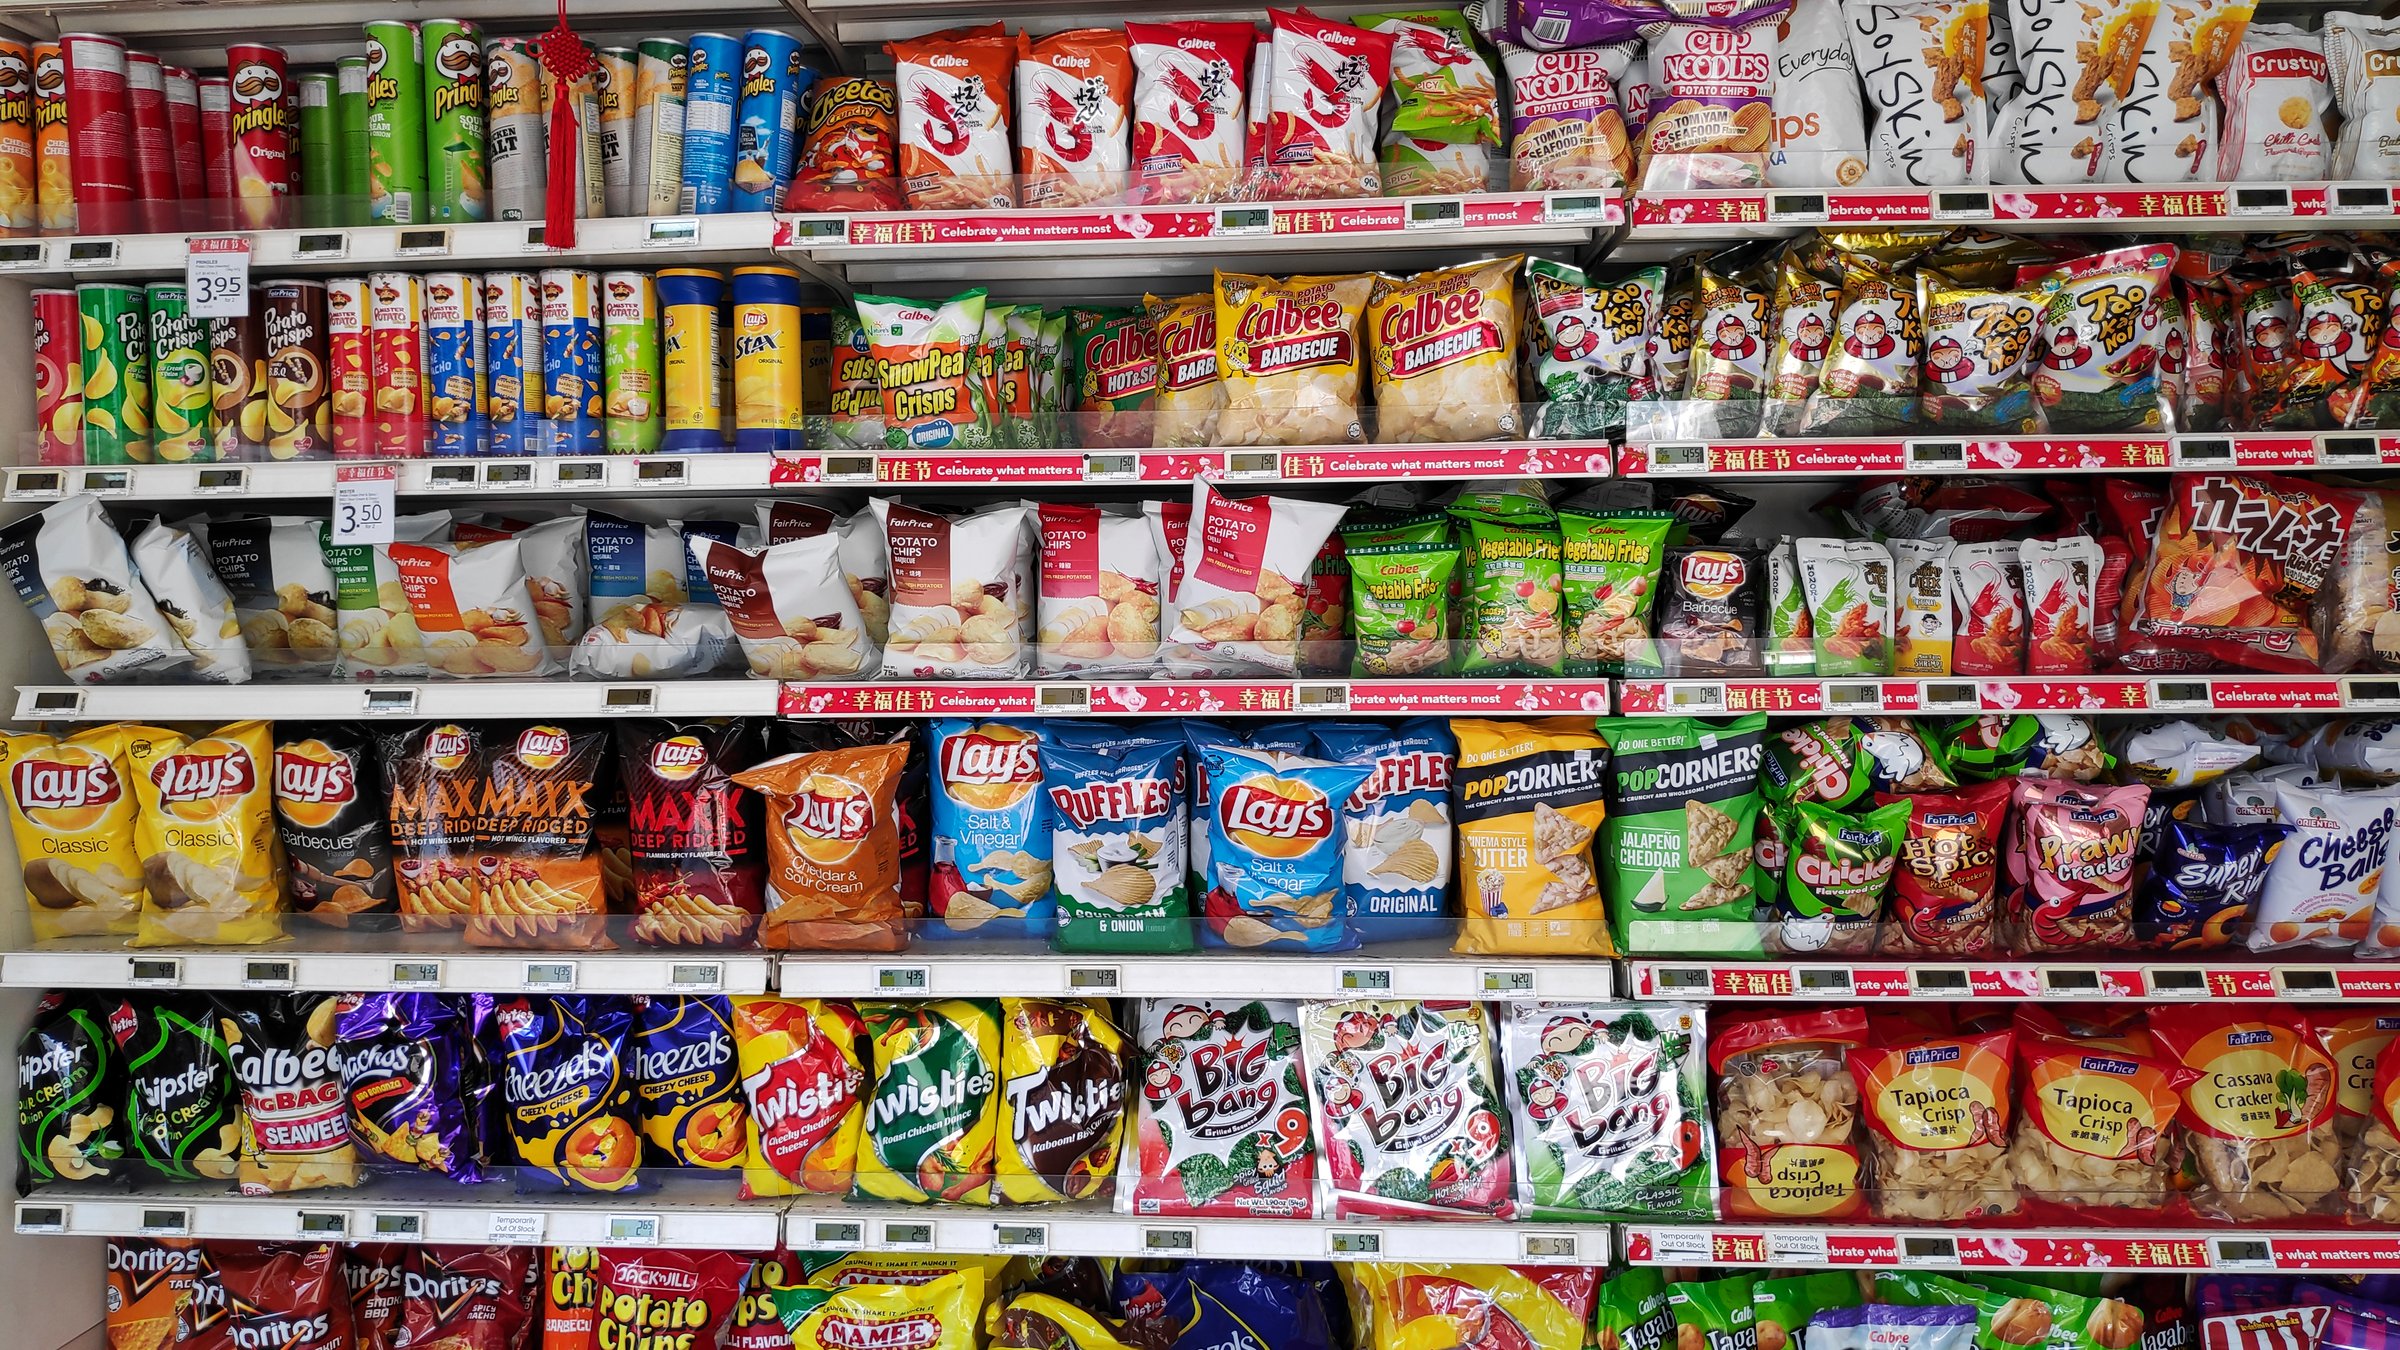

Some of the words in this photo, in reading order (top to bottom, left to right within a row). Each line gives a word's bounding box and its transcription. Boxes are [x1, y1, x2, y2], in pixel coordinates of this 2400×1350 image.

[1178, 37, 1216, 51] Calbee
[1317, 29, 1356, 47] Calbee
[1686, 31, 1748, 55] CUP
[930, 54, 969, 69] Calbee
[1053, 54, 1091, 69] Calbee
[1533, 52, 1598, 75] CUP
[1663, 54, 1769, 83] NOODLES
[1679, 86, 1715, 96] POTATO
[1718, 86, 1749, 96] CHIPS
[809, 78, 894, 127] Cheetos
[1534, 101, 1570, 115] POTATO
[1573, 96, 1600, 109] CHIPS
[232, 105, 288, 144] Pringles
[1675, 113, 1702, 127] TOM
[1703, 111, 1727, 123] YAM
[250, 144, 286, 161] Original
[1142, 158, 1182, 173] ORIGINAL
[852, 222, 937, 242] 幸福佳节
[941, 223, 999, 238] Celebrate
[1001, 224, 1031, 235] what
[1033, 223, 1078, 236] matters
[1079, 223, 1111, 234] most
[2080, 286, 2145, 320] Tao
[373, 310, 406, 322] POTATO
[1236, 299, 1340, 342] Calbee
[1260, 337, 1338, 368] BARBECUE
[1330, 460, 1389, 472] Celebrate
[1391, 460, 1420, 471] what
[1796, 453, 1859, 465] Celebrate
[1861, 453, 1890, 464] what
[936, 464, 996, 477] Celebrate
[998, 465, 1028, 476] what
[1030, 464, 1074, 476] matters
[340, 504, 382, 533] 3.50
[890, 517, 934, 530] FairPrice
[591, 536, 634, 546] POTATO
[1044, 531, 1086, 541] POTATO
[1207, 527, 1239, 540] CHIPS
[212, 537, 252, 548] FairPrice
[591, 545, 620, 555] CHIPS
[891, 537, 938, 548] POTATO
[1044, 540, 1071, 551] CHIPS
[893, 546, 922, 557] CHIPS
[219, 563, 245, 574] CHIPS
[1682, 600, 1738, 616] Barbecue
[852, 690, 936, 711] 幸福佳节
[939, 695, 997, 707] Celebrate
[999, 696, 1028, 706] what
[1424, 694, 1467, 704] matters
[1468, 694, 1501, 704] most
[2216, 690, 2275, 702] Celebrate
[2280, 690, 2306, 701] what
[1466, 752, 1481, 763] DO
[1483, 750, 1501, 762] ONE
[1500, 741, 1534, 759] BETTER!
[1616, 741, 1632, 752] DO
[1635, 739, 1652, 750] ONE
[1654, 735, 1685, 748] BETTER!
[946, 737, 1039, 785] Lay's
[1617, 743, 1763, 794] POPCORNERS
[22, 762, 110, 809] Lay's
[159, 753, 247, 802] Lay's
[274, 753, 346, 802] Lay's
[1049, 777, 1173, 830] RUFFLES
[1232, 786, 1326, 838] Lay's
[477, 817, 520, 834] DEEP
[523, 817, 588, 834] RIDGED
[968, 815, 997, 831] Salt
[1000, 817, 1012, 830] &
[1925, 812, 1976, 826] FairPrice
[2296, 818, 2340, 830] ORIENTAL
[391, 820, 438, 837] DEEP
[41, 837, 109, 855] Classic
[166, 829, 235, 848] Classic
[281, 829, 353, 851] Barbecue
[630, 831, 670, 848] DEEP
[672, 830, 746, 848] RIDGED
[960, 828, 1021, 849] Vinegar
[1467, 835, 1496, 846] CINEMA
[1498, 834, 1527, 846] STYLE
[1620, 830, 1681, 851] JALAPEÑO
[1251, 859, 1280, 874] Salt
[1282, 862, 1296, 874] &
[1620, 850, 1681, 869] CHEDDAR
[791, 856, 844, 880] Cheddar
[846, 871, 858, 882] &
[1370, 895, 1438, 914] ORIGINAL
[1100, 920, 1107, 932] &
[1110, 919, 1144, 934] ONION
[2228, 1032, 2274, 1045] FairPrice
[1190, 1034, 1269, 1091] BIG
[1906, 1048, 1960, 1063] FairPrice
[644, 1080, 676, 1094] CHEEZY
[677, 1072, 710, 1088] CHEESE
[2213, 1071, 2273, 1089] Cassava
[868, 1067, 995, 1130] Twisties
[1177, 1079, 1278, 1135] bang
[2053, 1087, 2134, 1116] Tapioca
[2214, 1092, 2273, 1110] Cracker
[1563, 1090, 1670, 1150] bang
[1922, 1106, 1966, 1124] Crisp
[2079, 1115, 2123, 1133] Crisp
[1635, 1187, 1683, 1201] CLASSIC
[1236, 1198, 1250, 1208] Net
[1646, 1198, 1683, 1210] FLAVOUR
[494, 1225, 509, 1233] Out
[511, 1225, 519, 1233] Of
[520, 1225, 537, 1233] Stock
[495, 1216, 538, 1226] Temporarily
[1659, 1232, 1706, 1242] Temporarily
[1773, 1233, 1819, 1243] Temporarily
[106, 1243, 199, 1274] Doritos
[1867, 1248, 1898, 1258] what
[2284, 1248, 2317, 1260] what
[2320, 1248, 2370, 1261] matters
[922, 1259, 945, 1267] MUNCH
[404, 1270, 499, 1300] Doritos
[363, 1308, 389, 1320] BBQ
[601, 1286, 708, 1330] Potato
[830, 1317, 928, 1346] MAMEE
